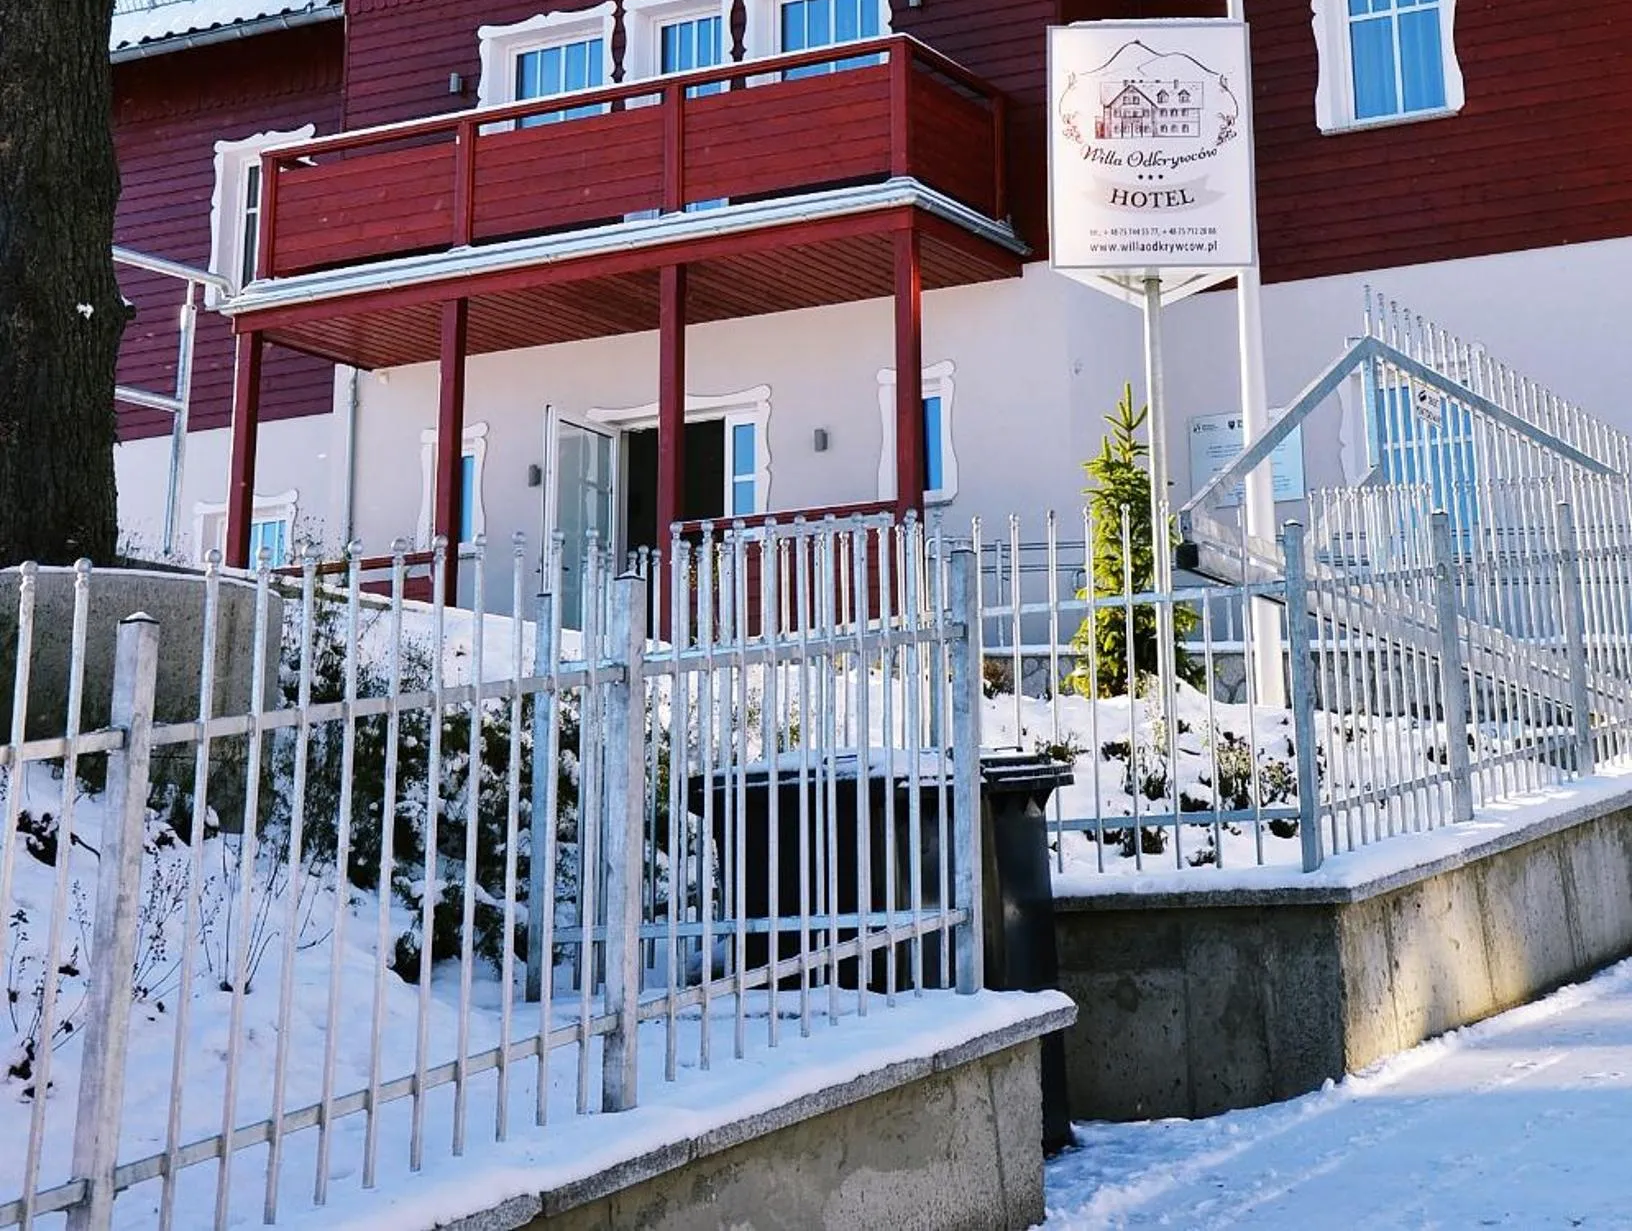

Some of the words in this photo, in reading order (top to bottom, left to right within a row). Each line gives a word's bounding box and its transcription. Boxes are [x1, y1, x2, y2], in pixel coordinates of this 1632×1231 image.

[1083, 145, 1122, 166] Willa
[1127, 146, 1218, 169] Odkrywców
[1109, 188, 1195, 208] HOTEL
[1090, 241, 1218, 253] www.willaodkrywcow.pl
